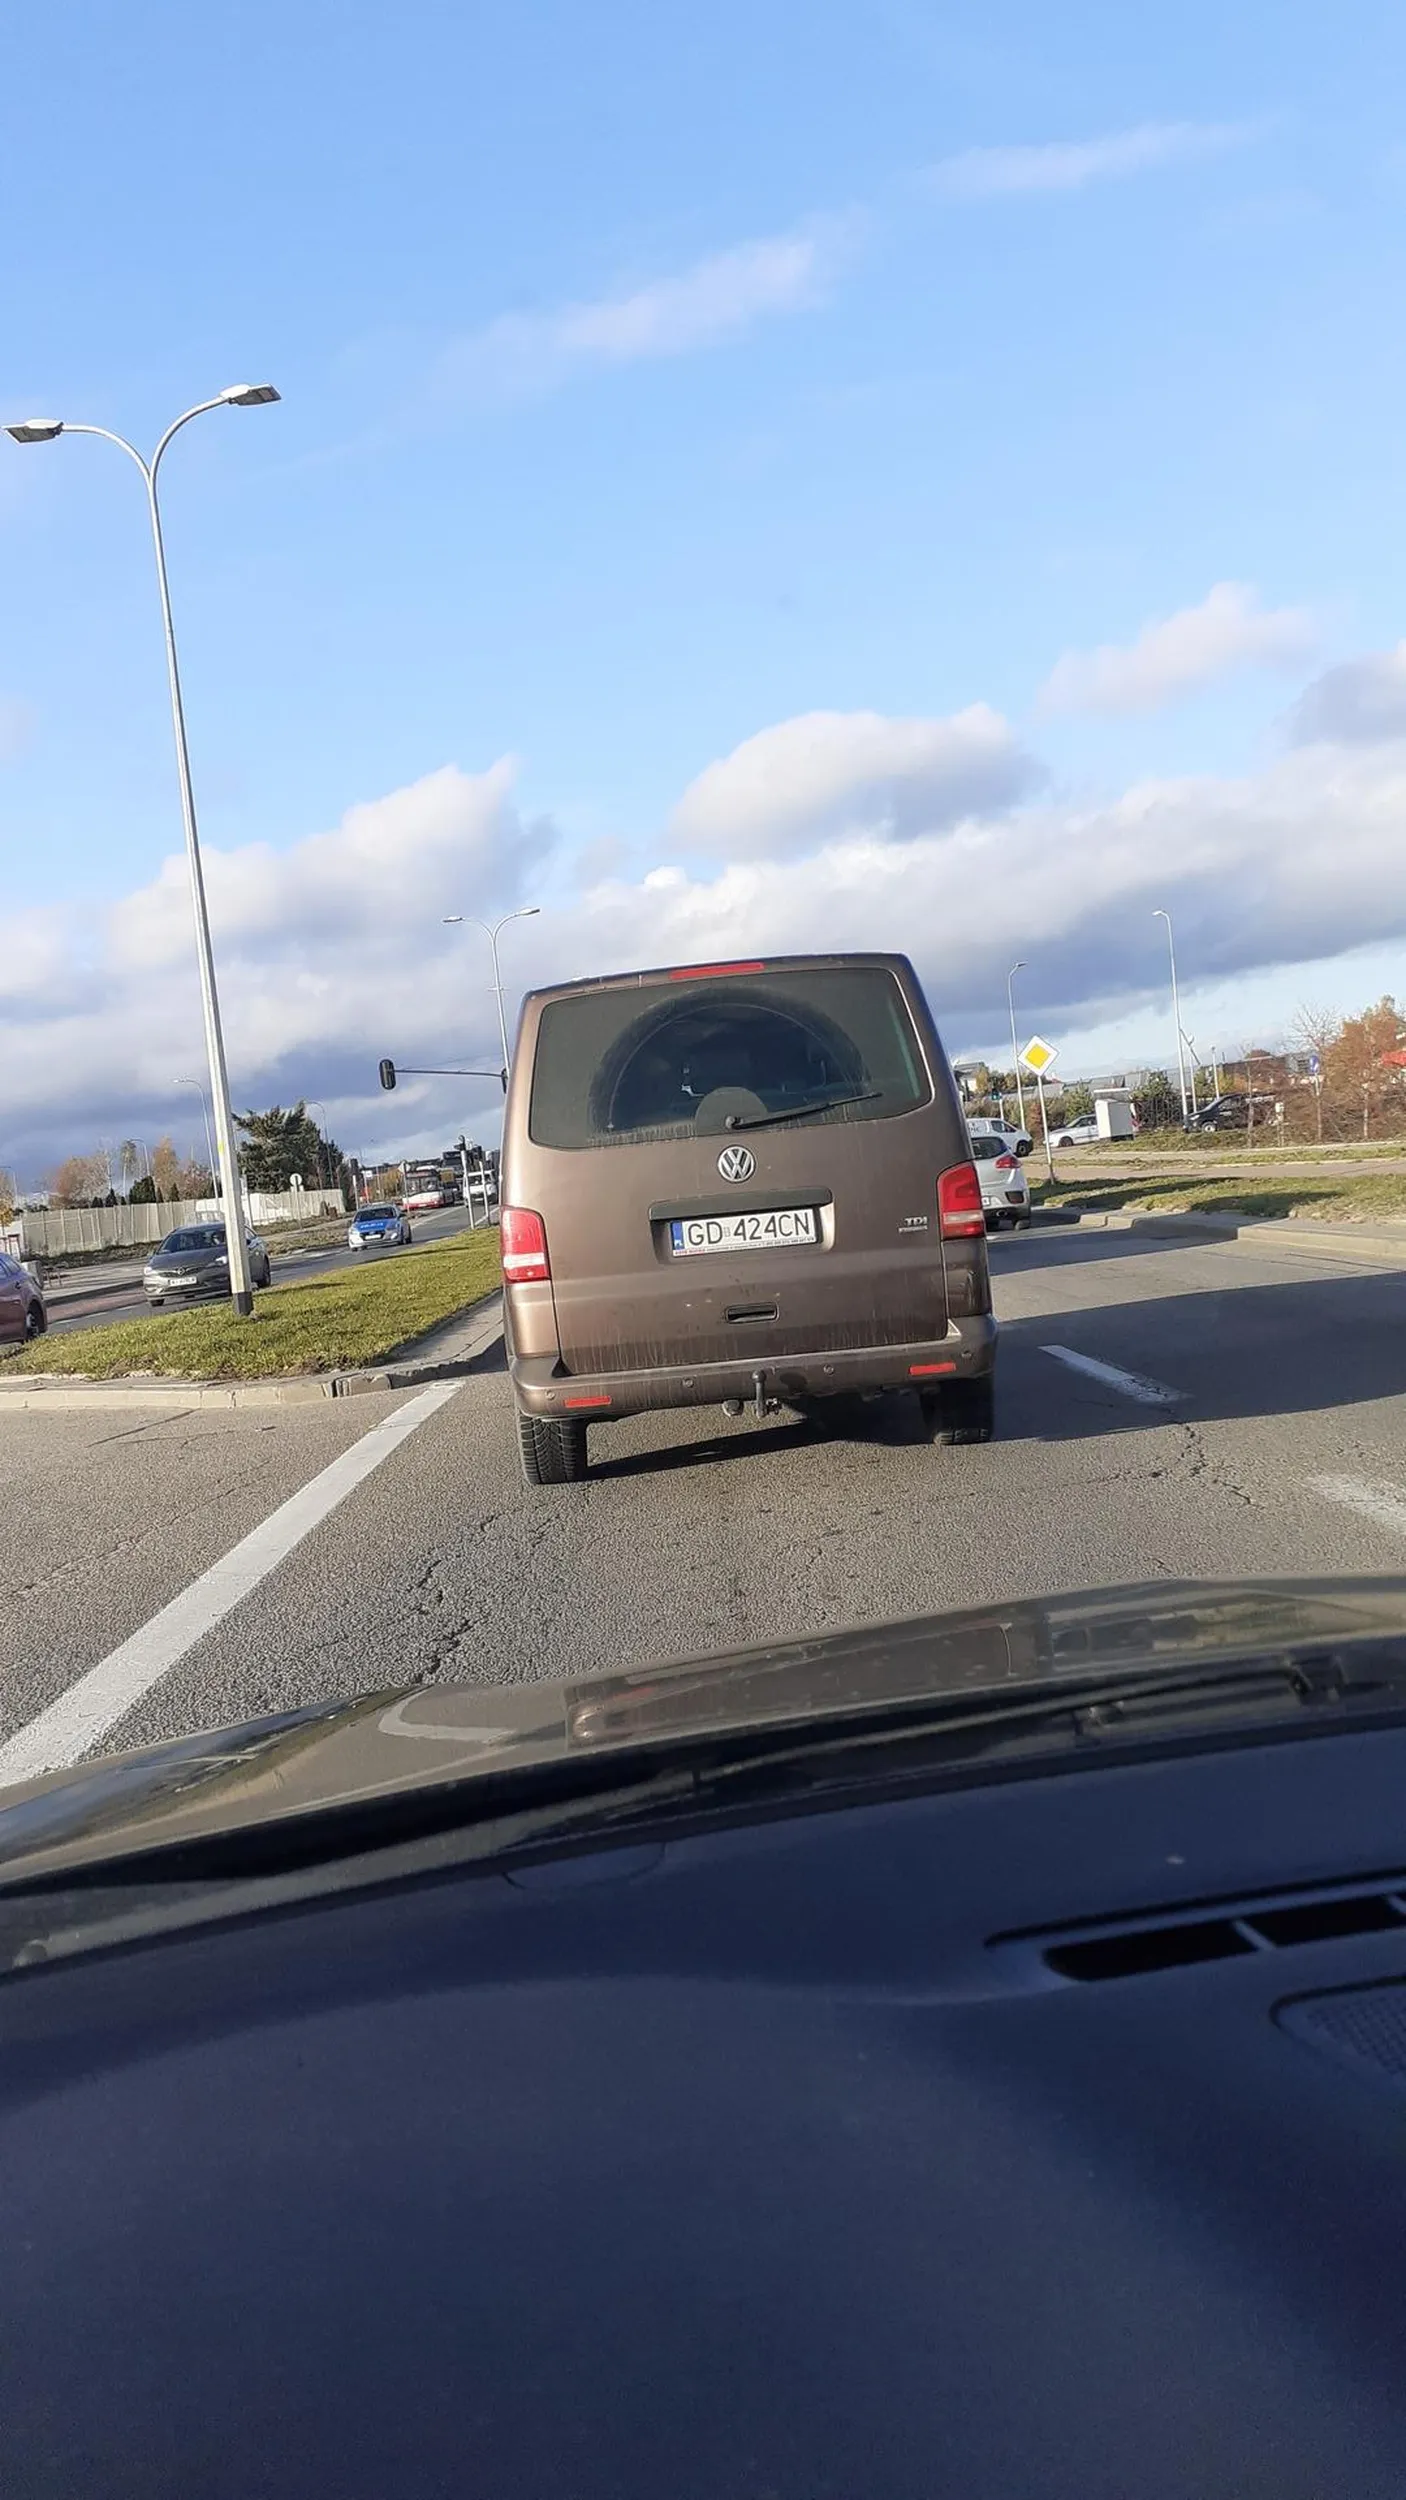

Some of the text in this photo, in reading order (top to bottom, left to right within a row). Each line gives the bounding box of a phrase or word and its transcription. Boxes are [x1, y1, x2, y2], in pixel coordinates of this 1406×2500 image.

[719, 1147, 754, 1182] VW
[688, 1221, 723, 1246] GD
[733, 1212, 809, 1241] 424CN
[904, 1216, 928, 1226] TDI
